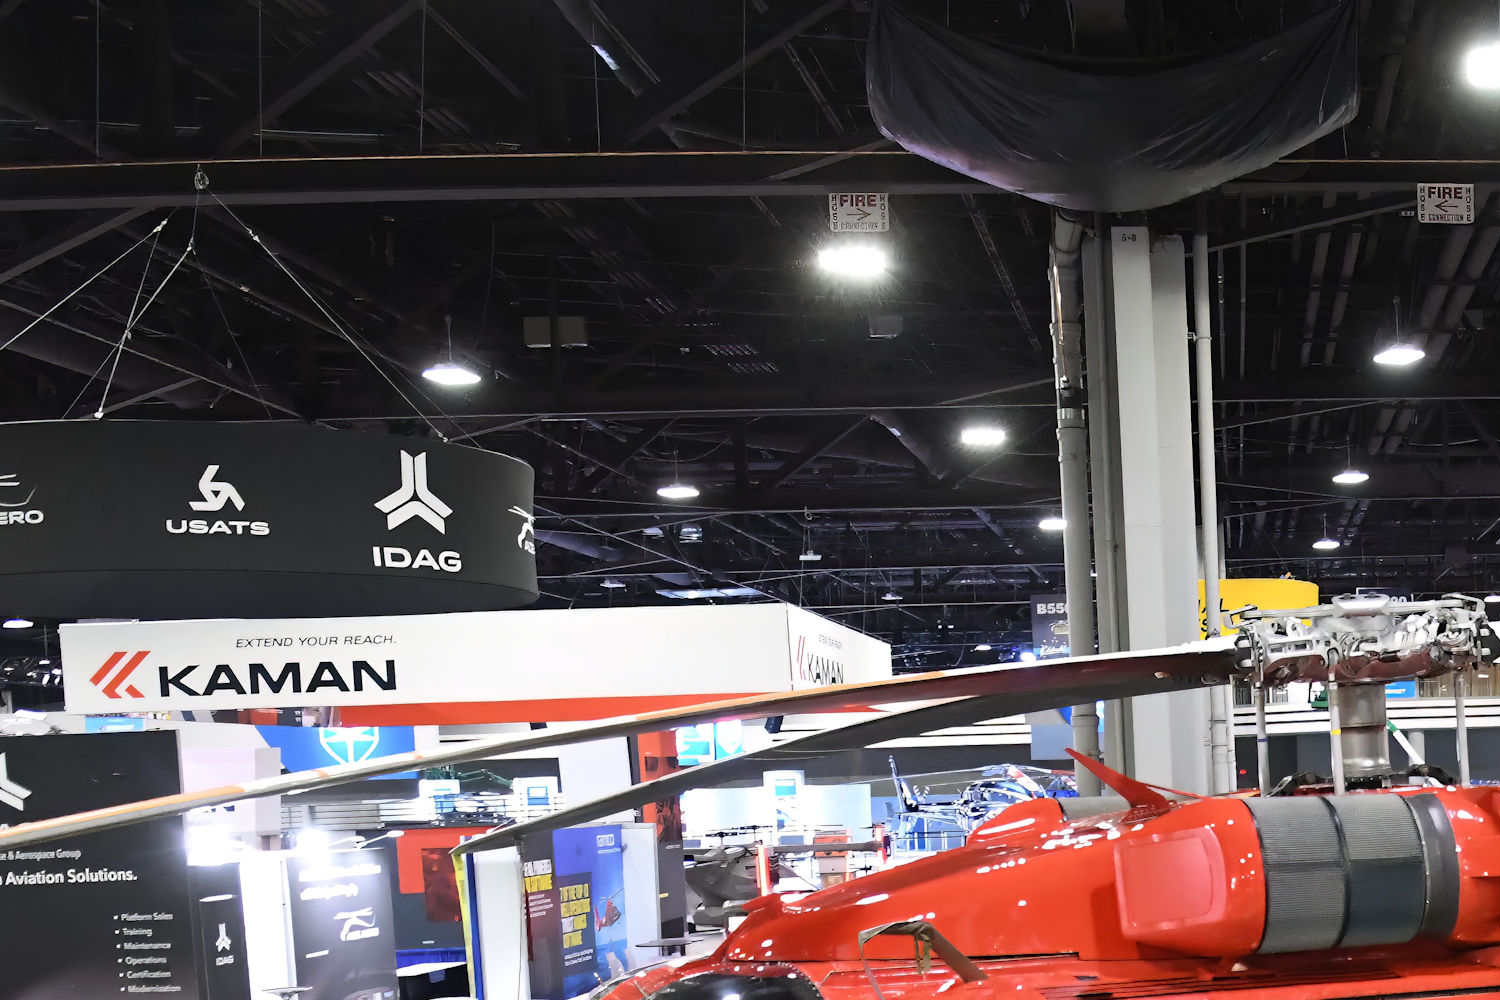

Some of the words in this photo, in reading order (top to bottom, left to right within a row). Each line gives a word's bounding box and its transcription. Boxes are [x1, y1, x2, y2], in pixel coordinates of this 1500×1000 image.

[1427, 186, 1463, 199] FIRE
[839, 194, 877, 207] FIRE
[165, 519, 270, 536] USATS
[372, 546, 462, 573] IDAG
[236, 637, 293, 648] EXTEND
[299, 636, 338, 647] YOUR
[344, 634, 397, 645] REACH.
[806, 652, 844, 686] KAMAN
[158, 659, 397, 697] KAMAN
[15, 850, 55, 862] Aerospace
[56, 848, 82, 861] Group
[5, 869, 65, 886] Aviation
[67, 867, 138, 884] Solutions.
[121, 913, 152, 921] Platform
[153, 912, 174, 920] Sales
[123, 927, 153, 937] Training
[125, 956, 167, 966] Operations
[127, 970, 171, 979] Certification
